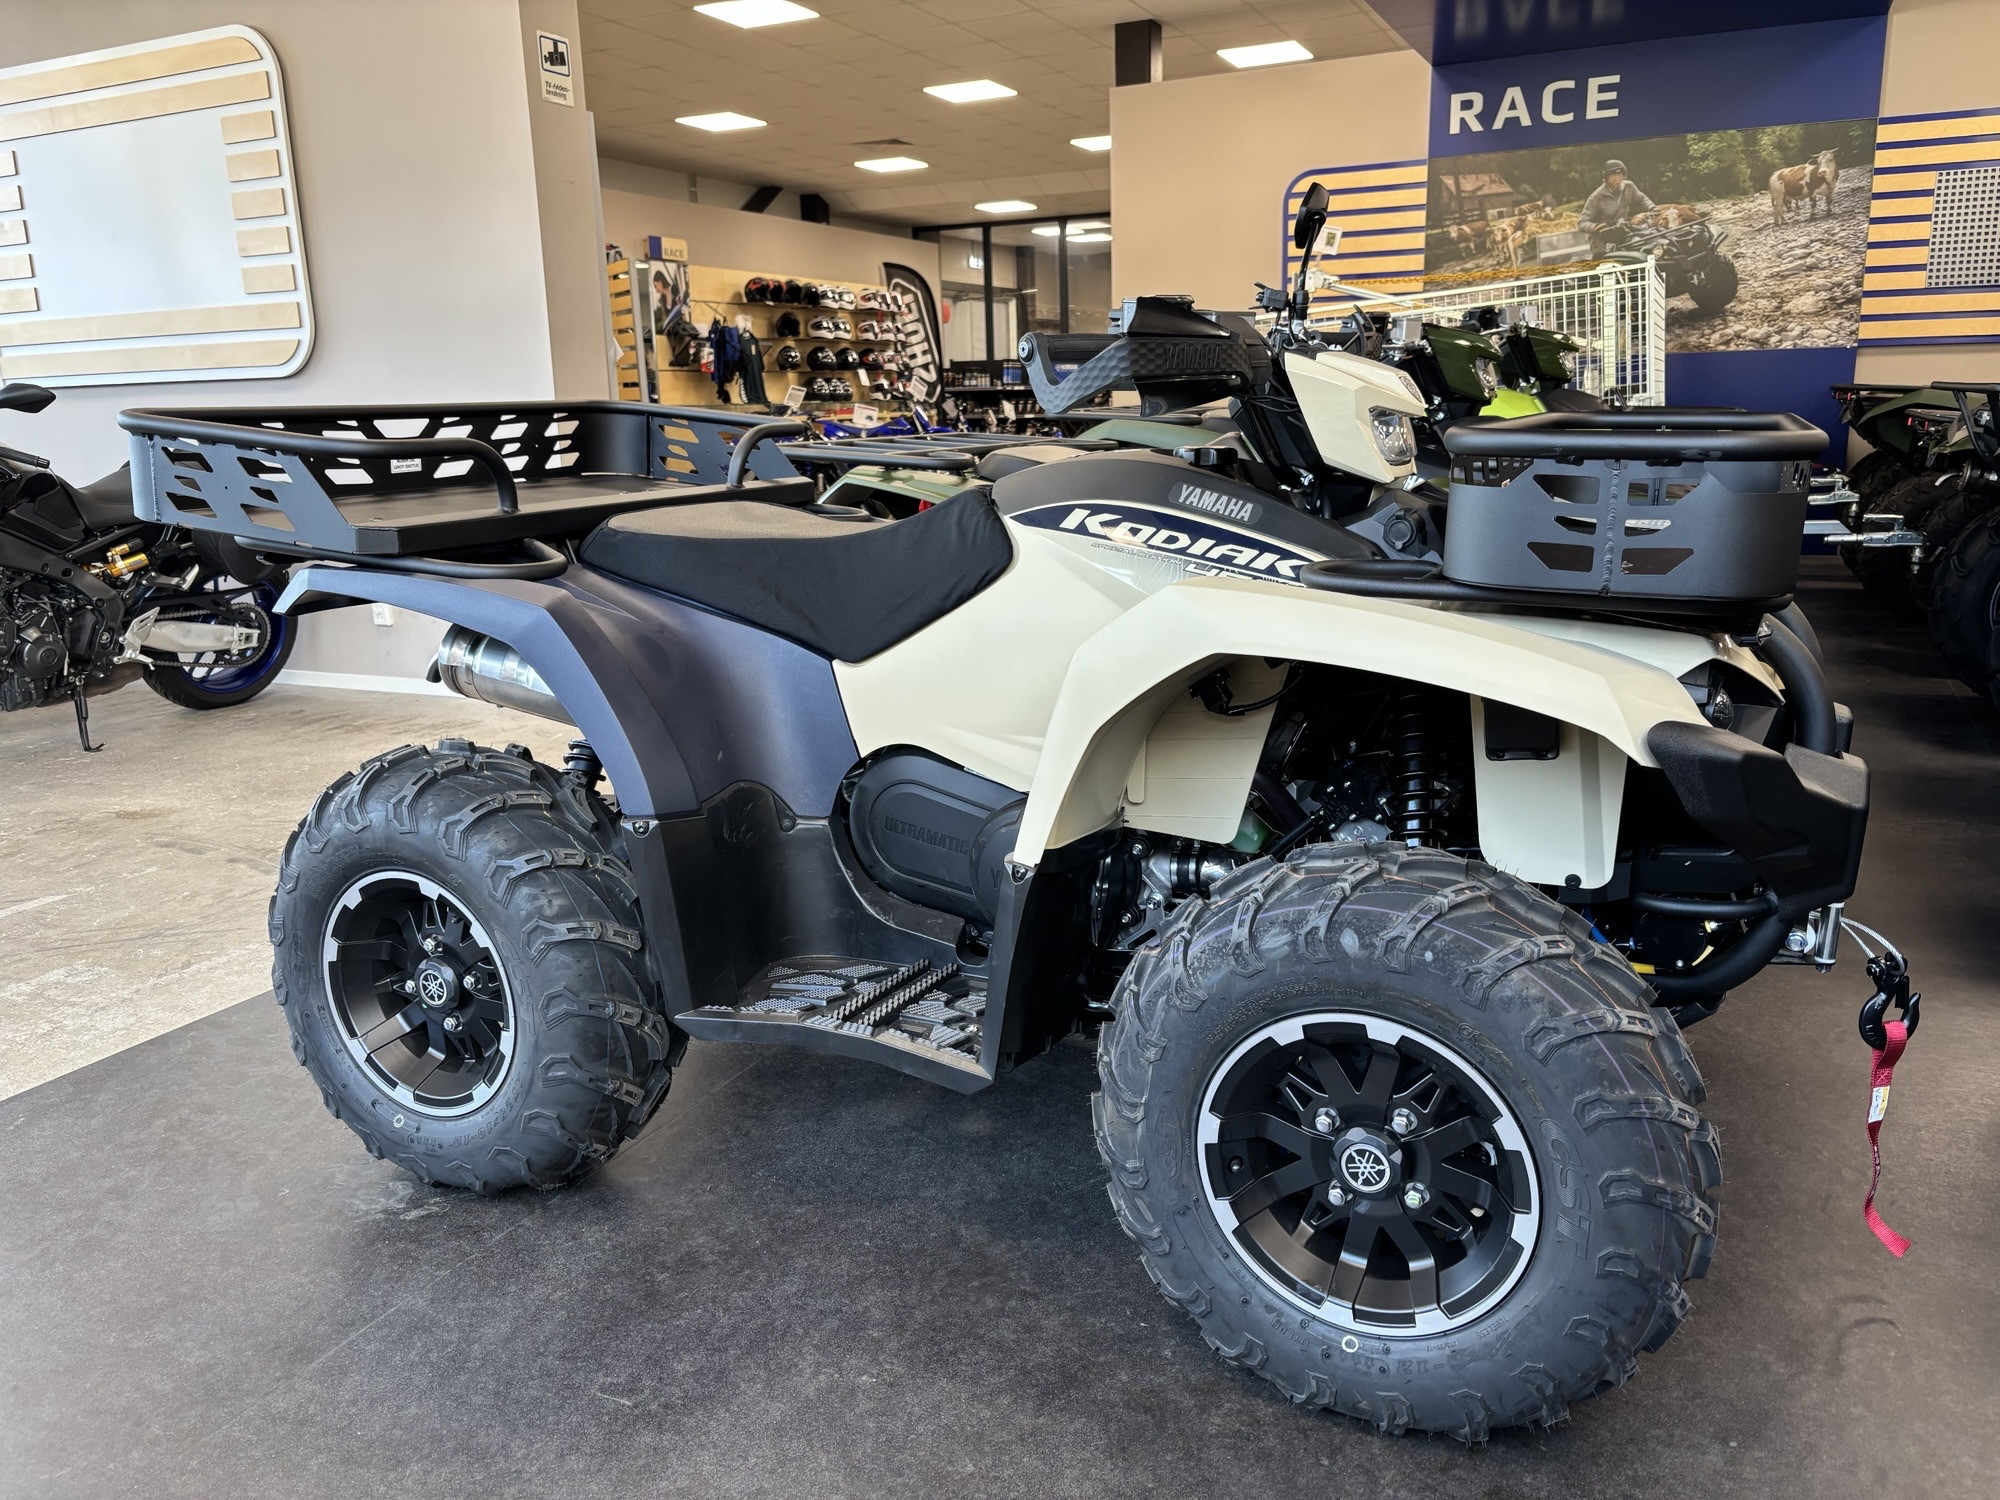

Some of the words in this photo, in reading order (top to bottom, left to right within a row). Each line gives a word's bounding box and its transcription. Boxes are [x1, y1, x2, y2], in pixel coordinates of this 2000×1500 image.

[1449, 74, 1621, 135] RACE
[1165, 346, 1222, 370] YAMAHA
[1178, 484, 1254, 522] YAMAHA
[1059, 508, 1311, 578] KODIAK
[1091, 541, 1134, 556] SPECIAL
[1137, 550, 1182, 566] EDITION
[884, 816, 969, 855] ULTRAMATIC
[1540, 1118, 1592, 1261] CST
